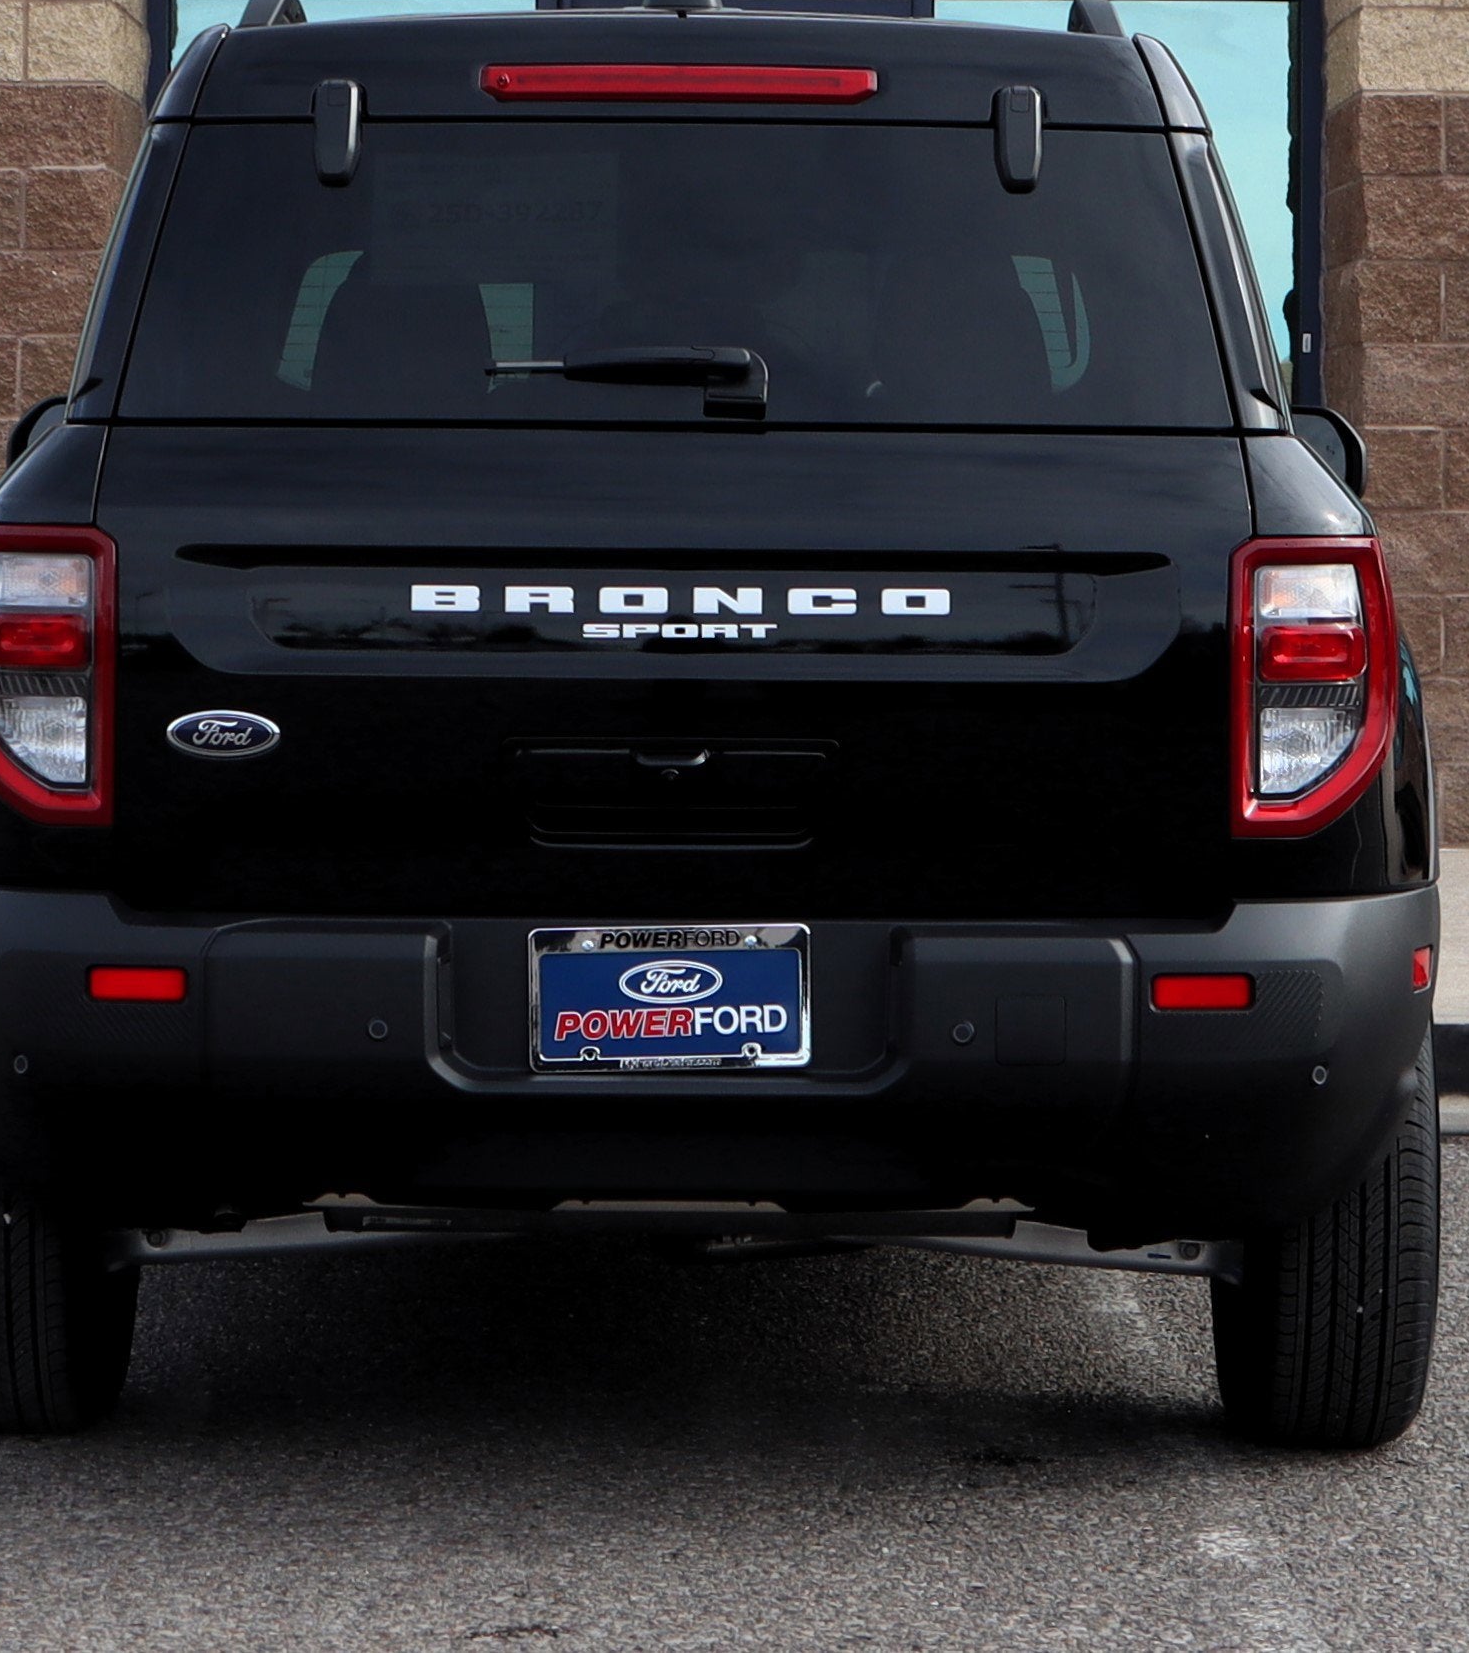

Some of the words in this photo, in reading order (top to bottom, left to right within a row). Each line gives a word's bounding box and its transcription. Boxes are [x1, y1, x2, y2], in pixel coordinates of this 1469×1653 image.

[410, 584, 951, 615] BRONCO
[581, 623, 778, 640] SPORT
[192, 719, 253, 746] Ford
[599, 929, 741, 949] POWERFORD
[640, 968, 701, 995] Ford
[554, 1004, 788, 1041] POWERFORD
